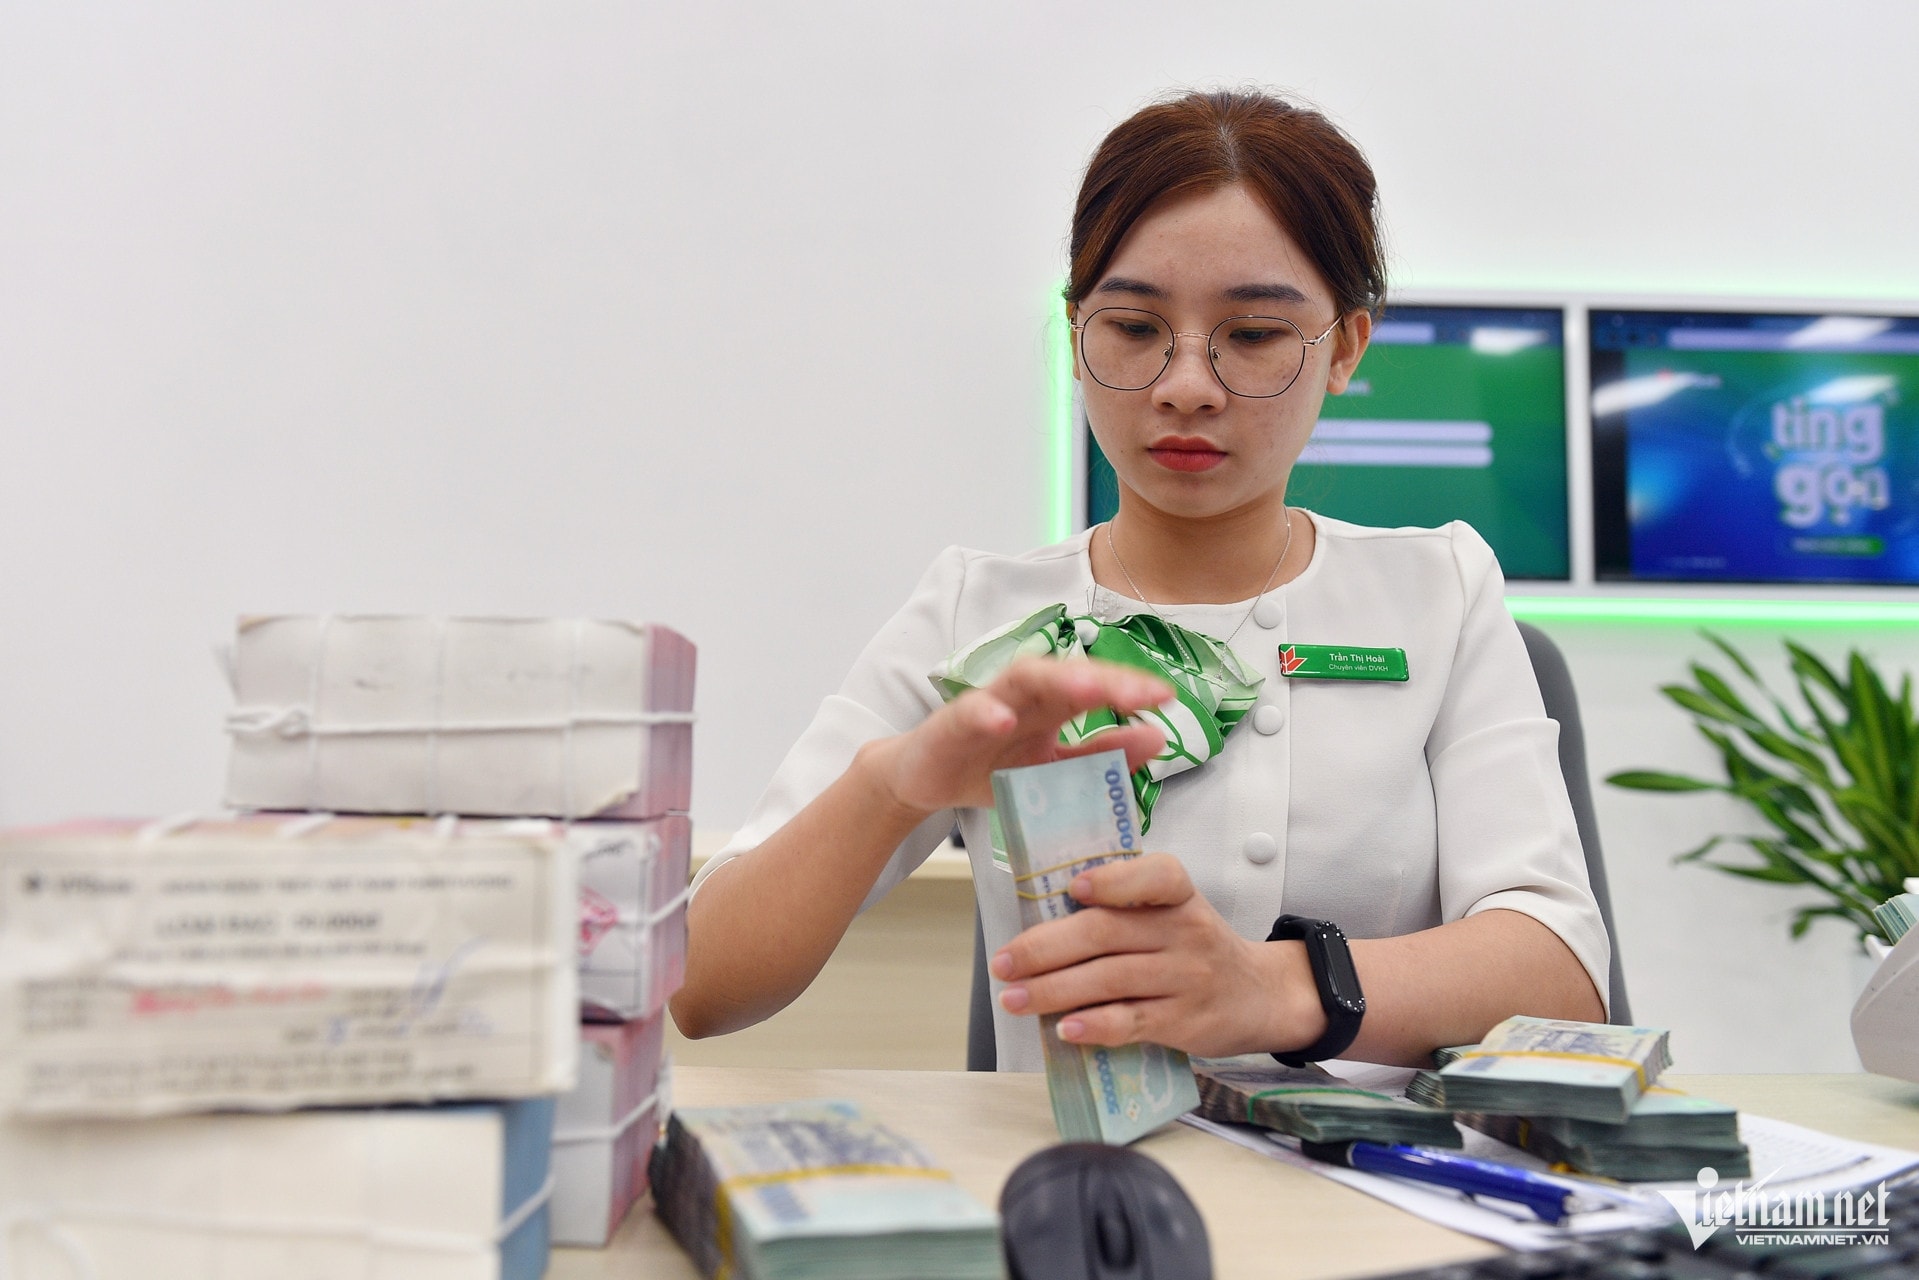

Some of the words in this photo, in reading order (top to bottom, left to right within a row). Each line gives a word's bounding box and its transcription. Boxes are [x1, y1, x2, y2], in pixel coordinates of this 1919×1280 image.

[1329, 652, 1348, 661] Trần
[1350, 654, 1364, 664] Thị
[1366, 655, 1385, 663] Hoài
